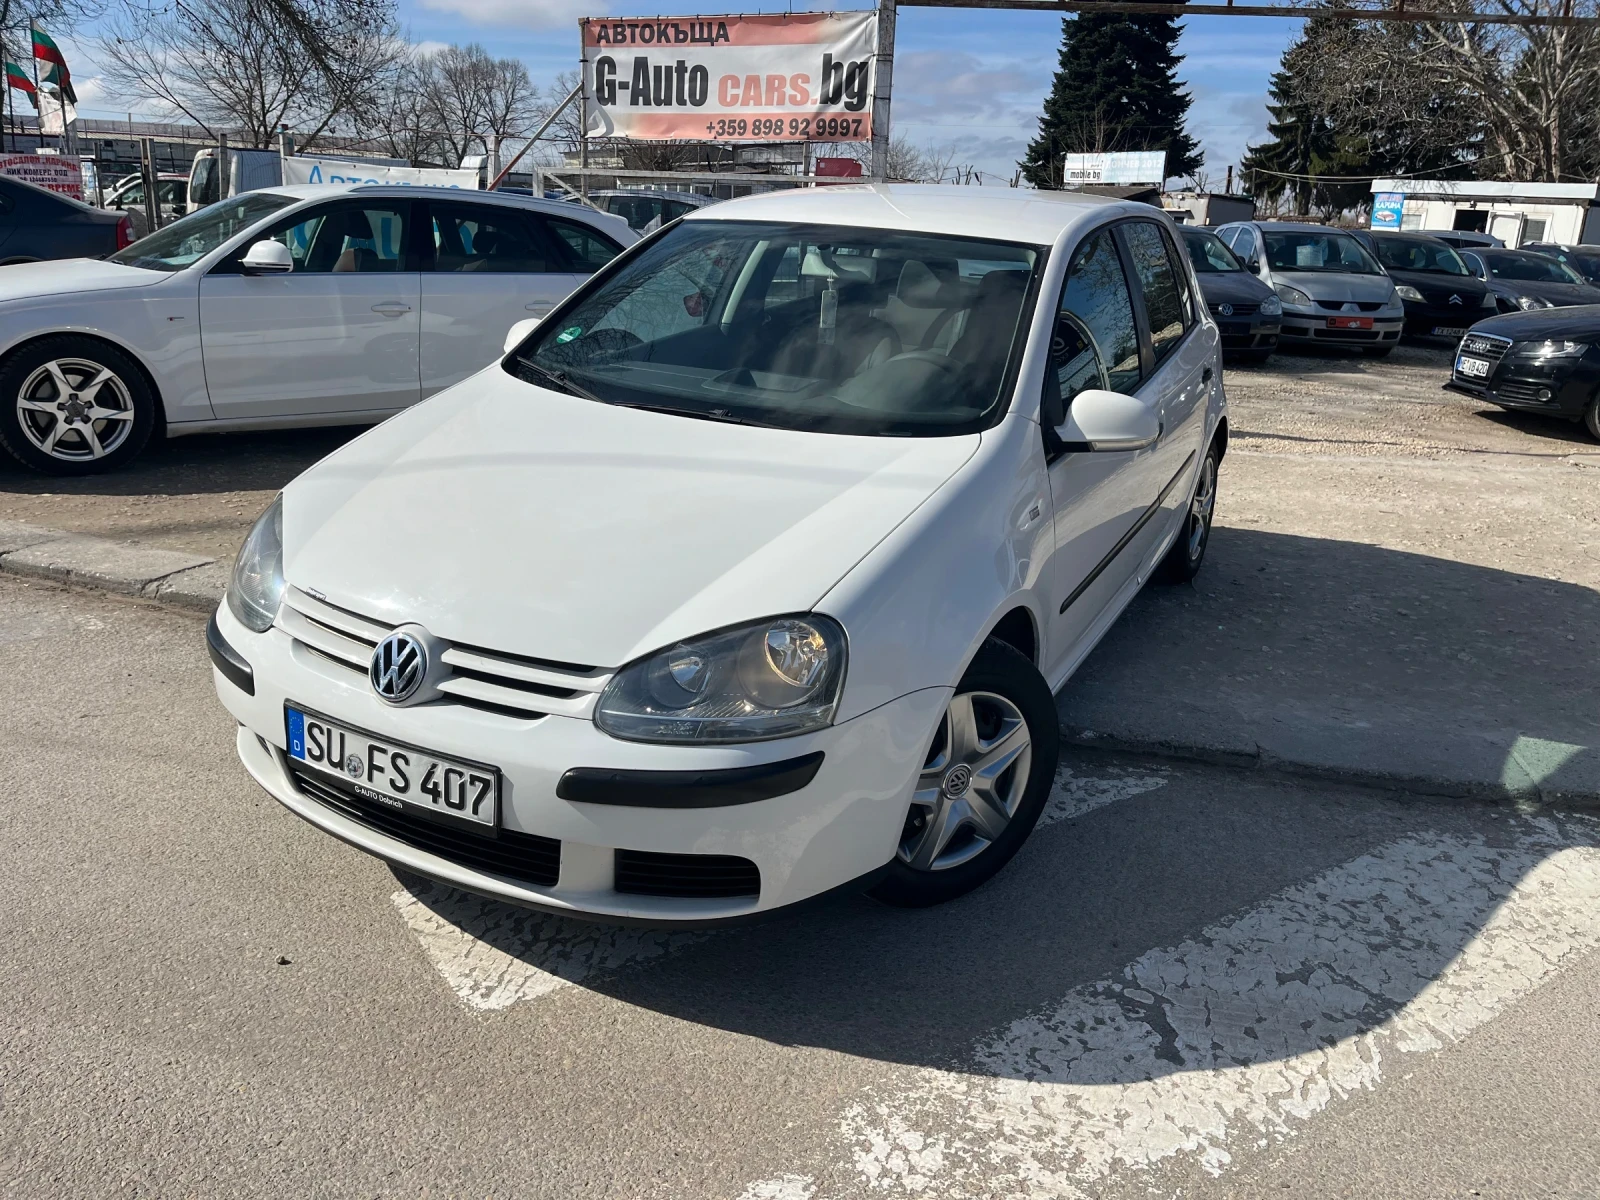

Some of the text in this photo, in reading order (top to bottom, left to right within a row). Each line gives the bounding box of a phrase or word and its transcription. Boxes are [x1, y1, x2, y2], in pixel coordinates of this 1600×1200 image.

[596, 21, 730, 46] АВТОКЪЩА
[596, 55, 709, 107] G-Auto
[706, 117, 863, 137] +359 898 92 9997
[293, 739, 301, 752] D
[306, 721, 491, 816] SU FS 407
[354, 785, 403, 809] G-AUTO Dobrich
